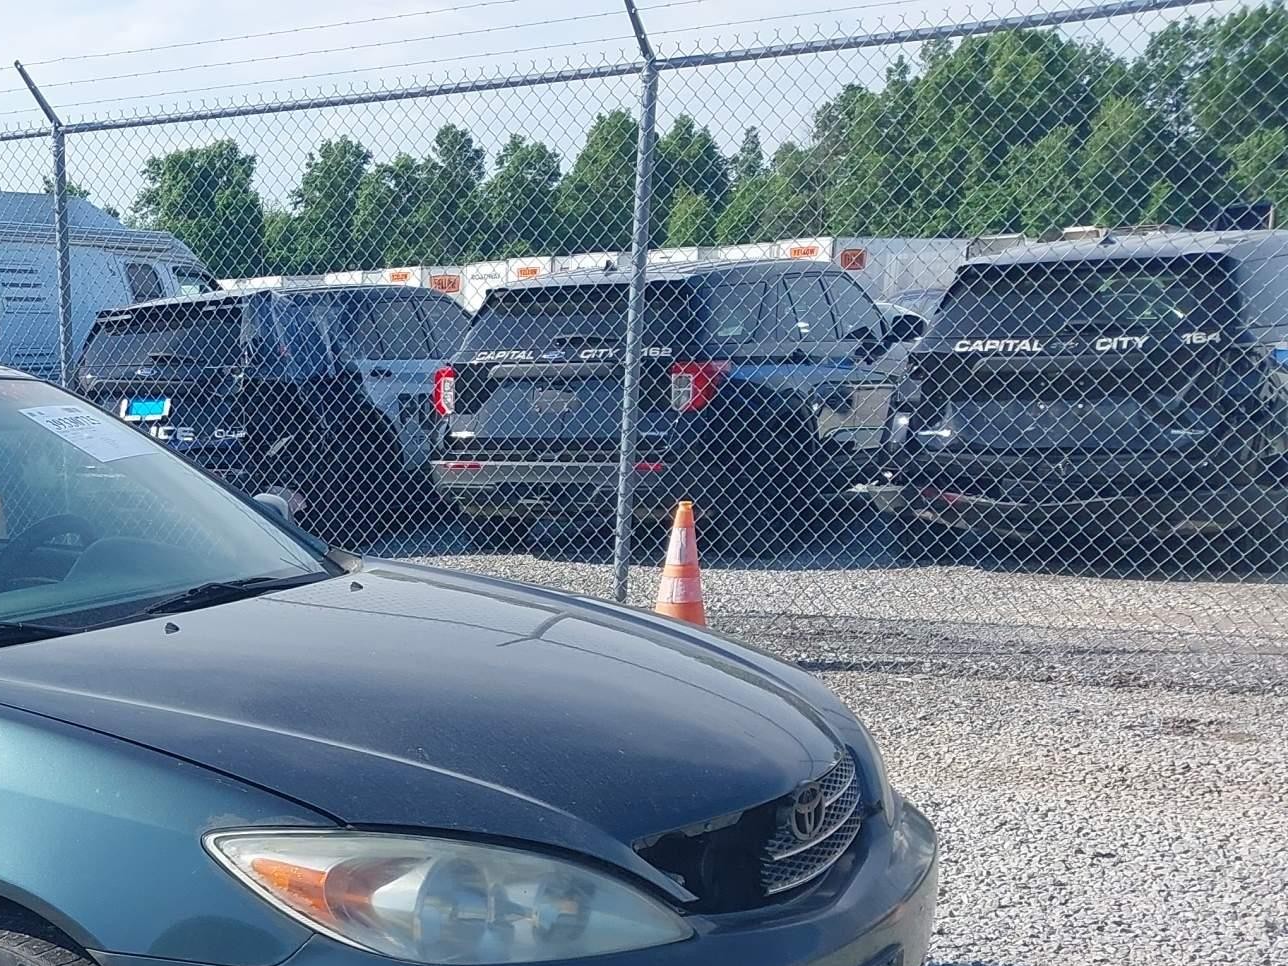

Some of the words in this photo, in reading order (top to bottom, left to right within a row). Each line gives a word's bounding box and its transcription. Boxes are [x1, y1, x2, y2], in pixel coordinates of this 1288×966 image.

[953, 339, 1042, 352] CAPITAL
[1095, 336, 1150, 350] CITY
[1181, 332, 1222, 344] 164
[475, 350, 534, 361] CAPITAL
[579, 349, 620, 359] CITY
[641, 347, 673, 357] 162
